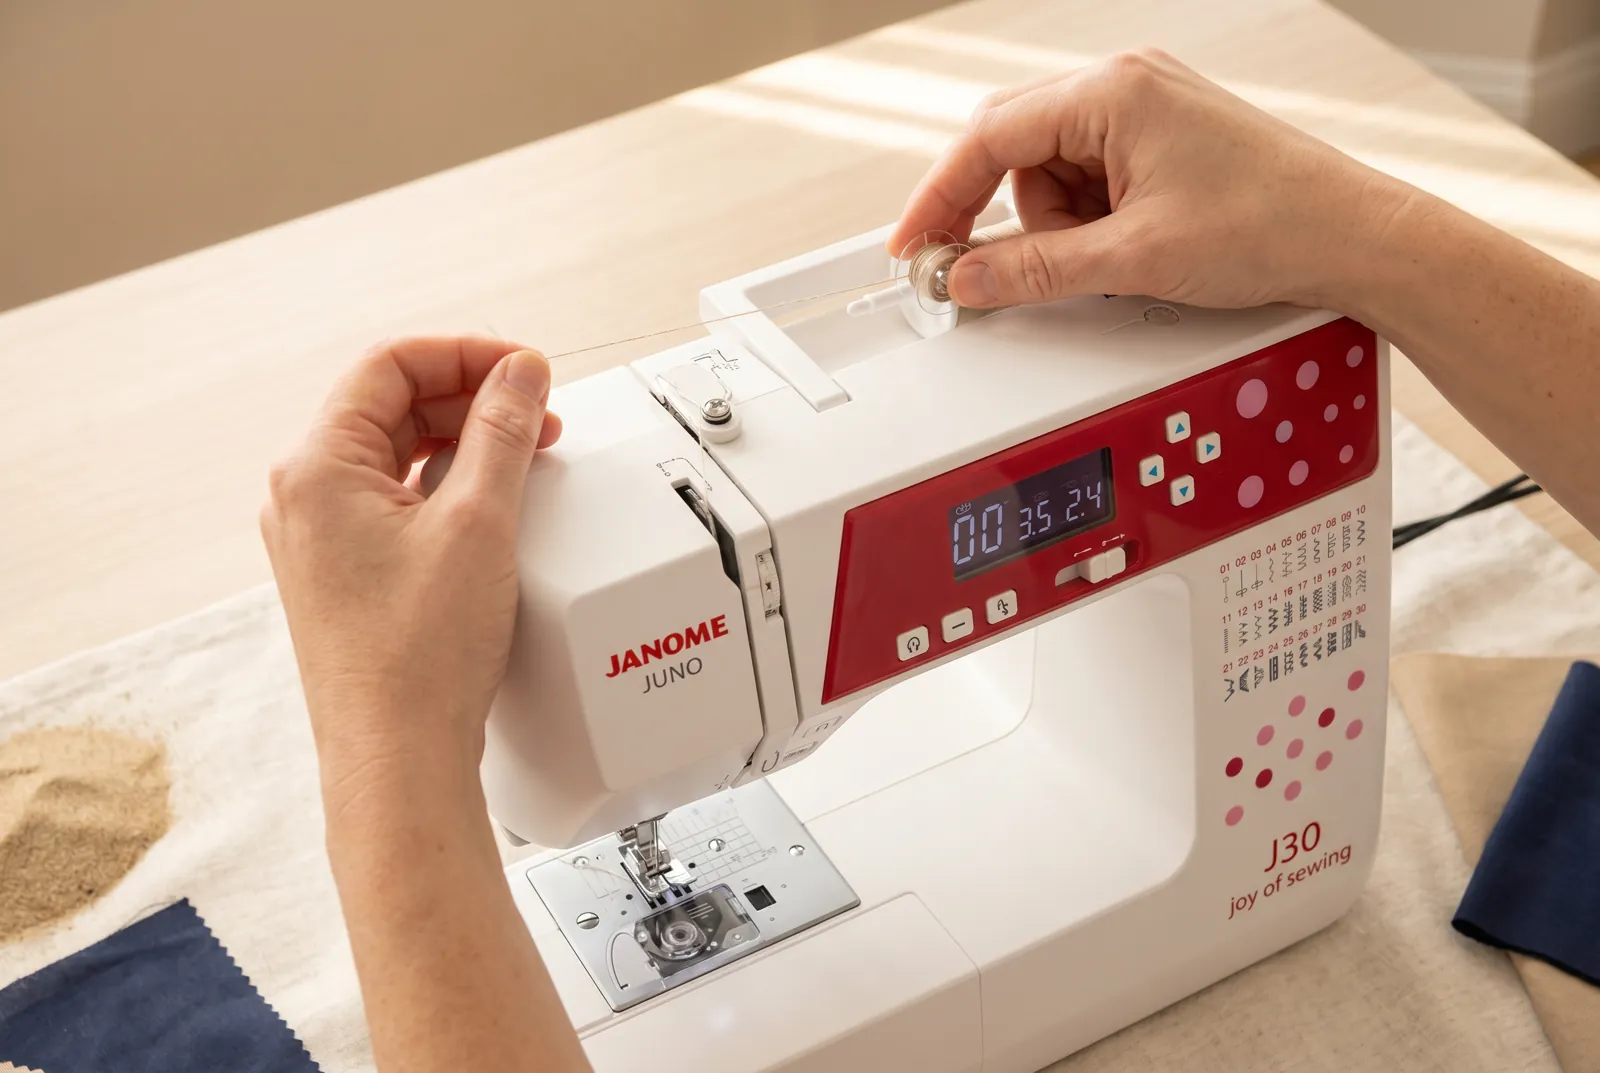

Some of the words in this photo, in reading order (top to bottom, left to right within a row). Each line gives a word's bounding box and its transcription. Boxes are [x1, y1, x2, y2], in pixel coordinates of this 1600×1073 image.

[953, 503, 1003, 565] 00
[1019, 500, 1051, 541] 3.5
[1066, 481, 1102, 522] 2.4
[1220, 563, 1230, 574] 01
[1235, 556, 1246, 567] 02
[1251, 550, 1262, 561] 03
[1266, 543, 1277, 554] 04
[1281, 537, 1292, 548] 05
[1296, 531, 1307, 541] 06
[1311, 524, 1322, 535] 07
[1326, 518, 1337, 528] 08
[1341, 511, 1352, 522] 09
[1356, 505, 1366, 515] 10
[1238, 606, 1248, 617] 12
[1253, 600, 1264, 610] 13
[1268, 594, 1278, 604] 14
[1284, 587, 1293, 597] 16
[1298, 580, 1308, 591] 17
[1313, 573, 1323, 584] 18
[1328, 567, 1337, 577] 19
[1341, 561, 1352, 572] 20
[1356, 555, 1366, 566] 21
[605, 614, 729, 678] JANOME
[1223, 662, 1233, 673] 21
[1238, 655, 1249, 667] 22
[1253, 649, 1264, 660] 23
[1268, 643, 1279, 654] 24
[1283, 636, 1294, 647] 25
[1298, 629, 1309, 641] 26
[1327, 616, 1337, 628] 28
[1342, 610, 1352, 621] 29
[1356, 603, 1367, 615] 30
[643, 657, 703, 694] JUNO
[1264, 821, 1321, 873] J30
[1228, 889, 1258, 920] joy
[1263, 873, 1283, 897] of
[1287, 844, 1352, 887] sewing
